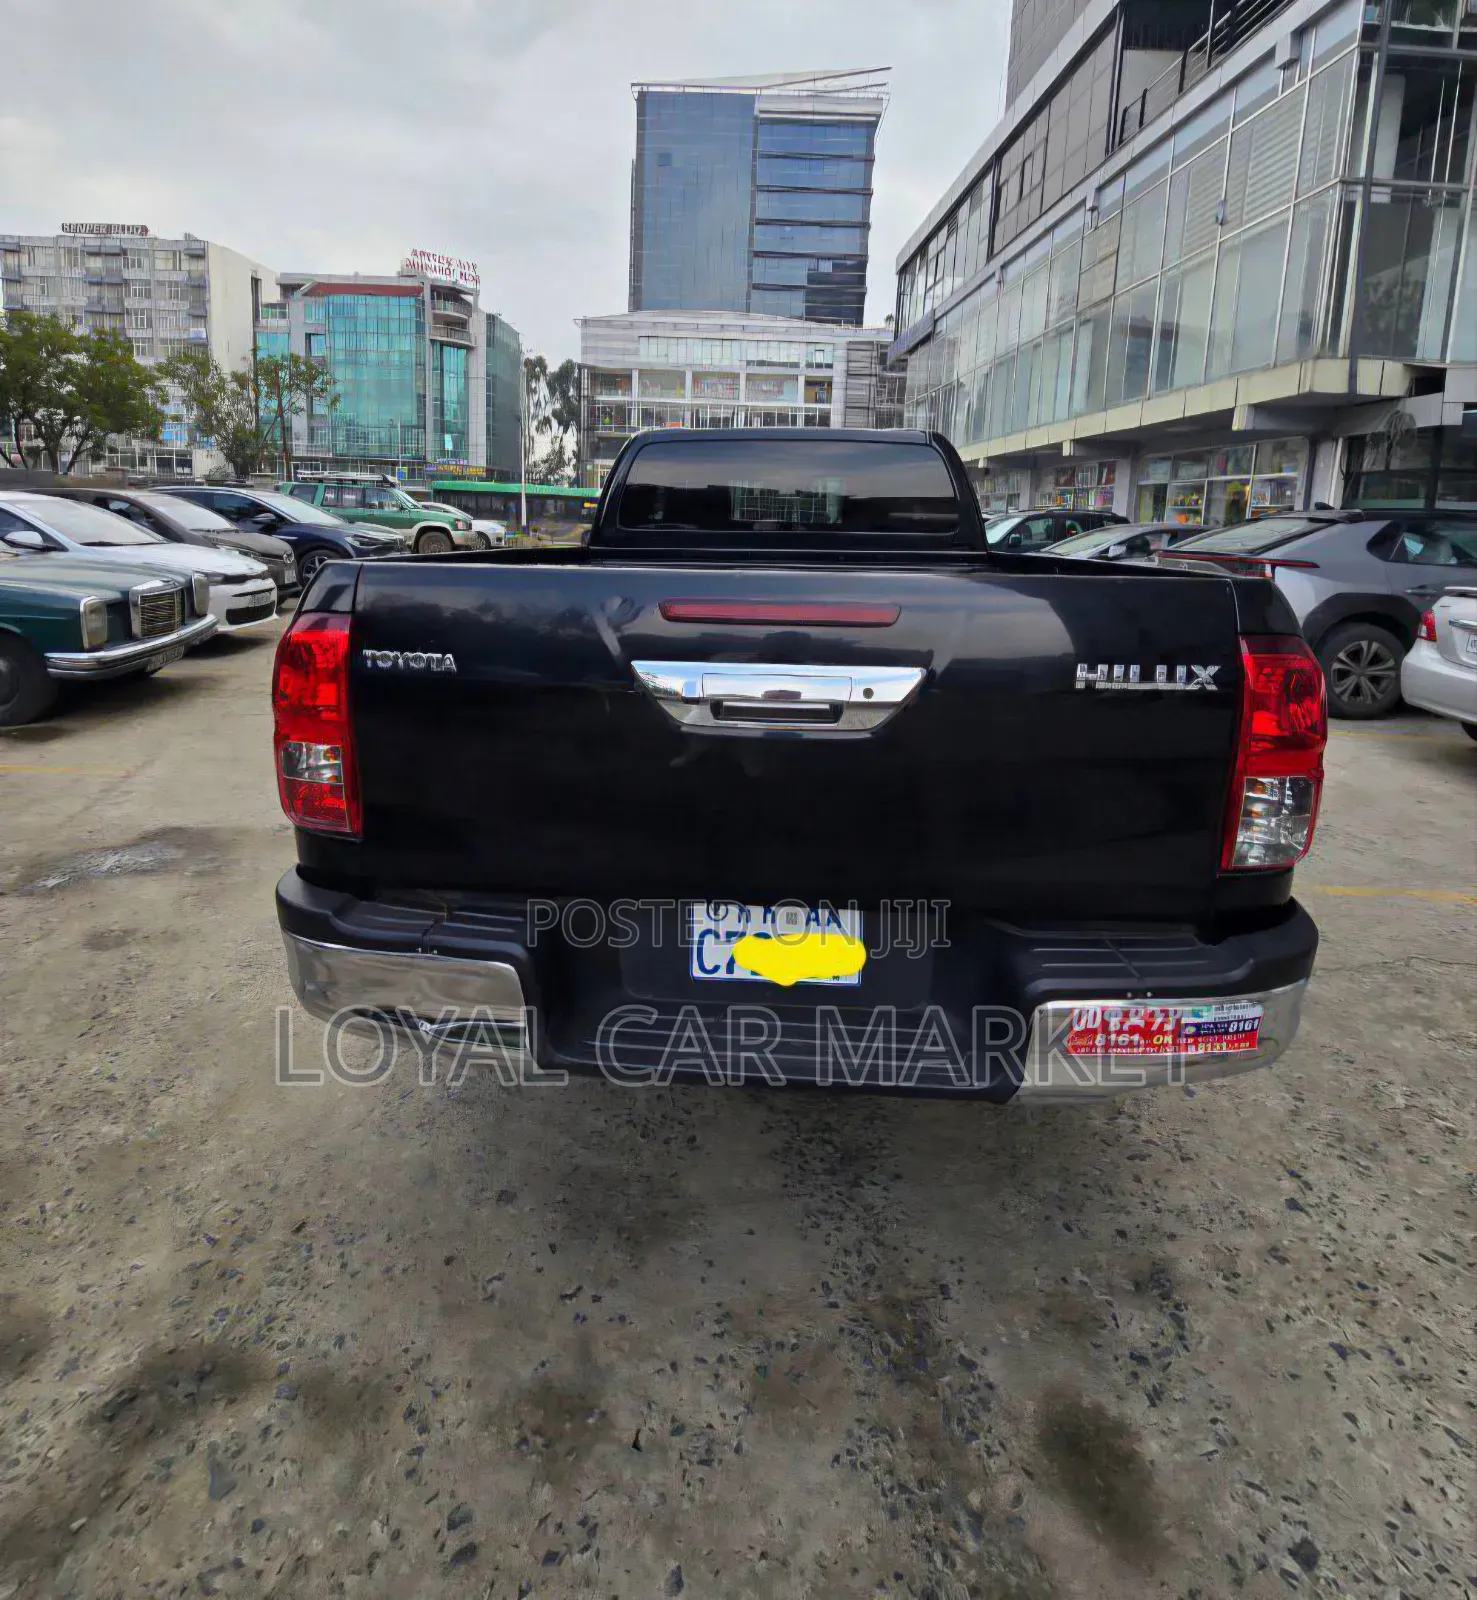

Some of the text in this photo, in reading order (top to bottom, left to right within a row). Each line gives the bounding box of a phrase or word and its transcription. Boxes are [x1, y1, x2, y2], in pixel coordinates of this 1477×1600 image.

[362, 649, 457, 672] TOYOTA
[1075, 664, 1221, 690] HILUX
[1094, 1032, 1141, 1047] 8161
